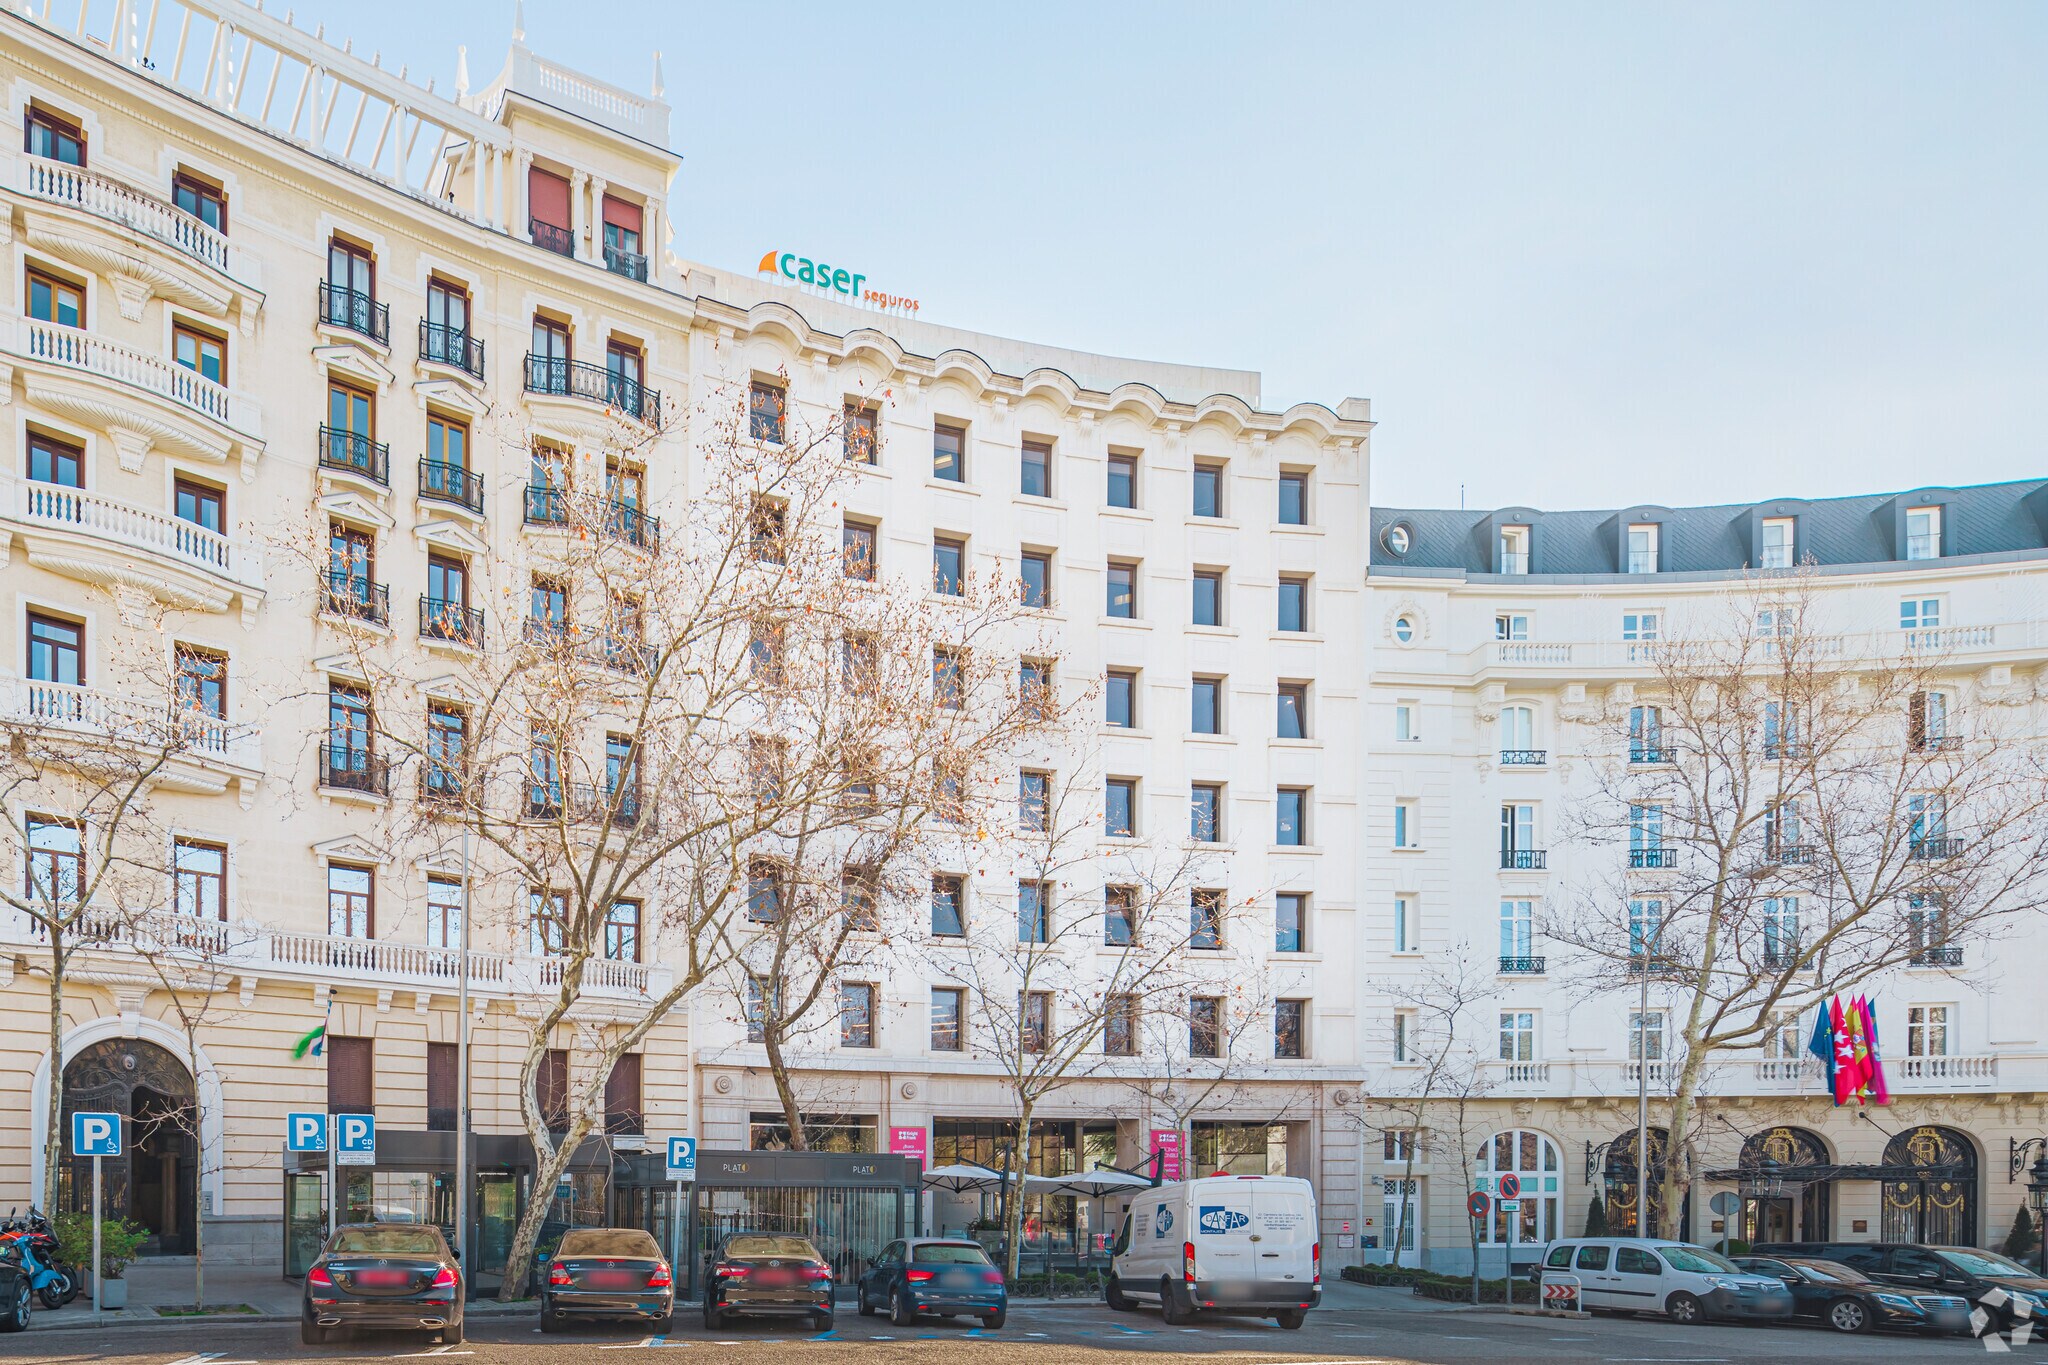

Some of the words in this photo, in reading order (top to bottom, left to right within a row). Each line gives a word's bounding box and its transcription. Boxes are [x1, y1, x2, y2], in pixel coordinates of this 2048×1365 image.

[780, 253, 866, 297] caser
[864, 289, 919, 310] seguros
[84, 1118, 111, 1150] P
[296, 1117, 319, 1147] P
[346, 1119, 367, 1148] P
[673, 1140, 690, 1165] P
[1205, 1211, 1246, 1229] DANFAR
